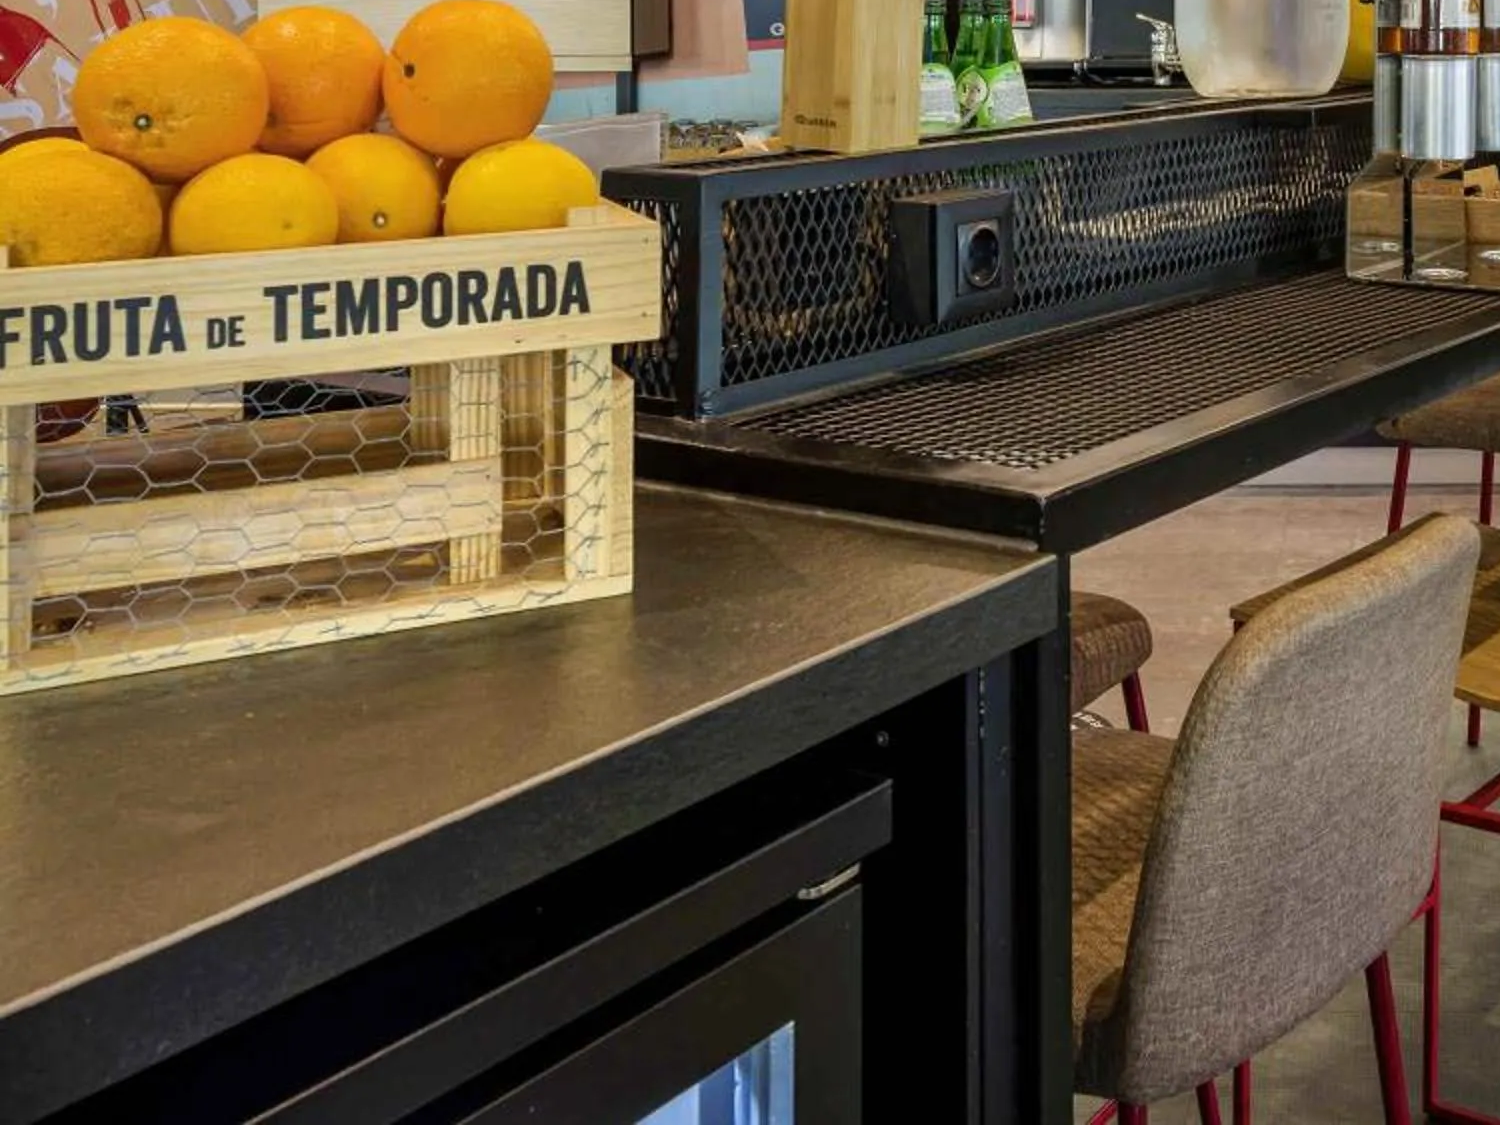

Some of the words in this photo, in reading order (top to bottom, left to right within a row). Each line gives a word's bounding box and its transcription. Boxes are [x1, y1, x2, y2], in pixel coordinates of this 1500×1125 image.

[0, 293, 187, 370] FRUTA
[207, 315, 246, 349] DE
[263, 260, 591, 343] TEMPORADA
